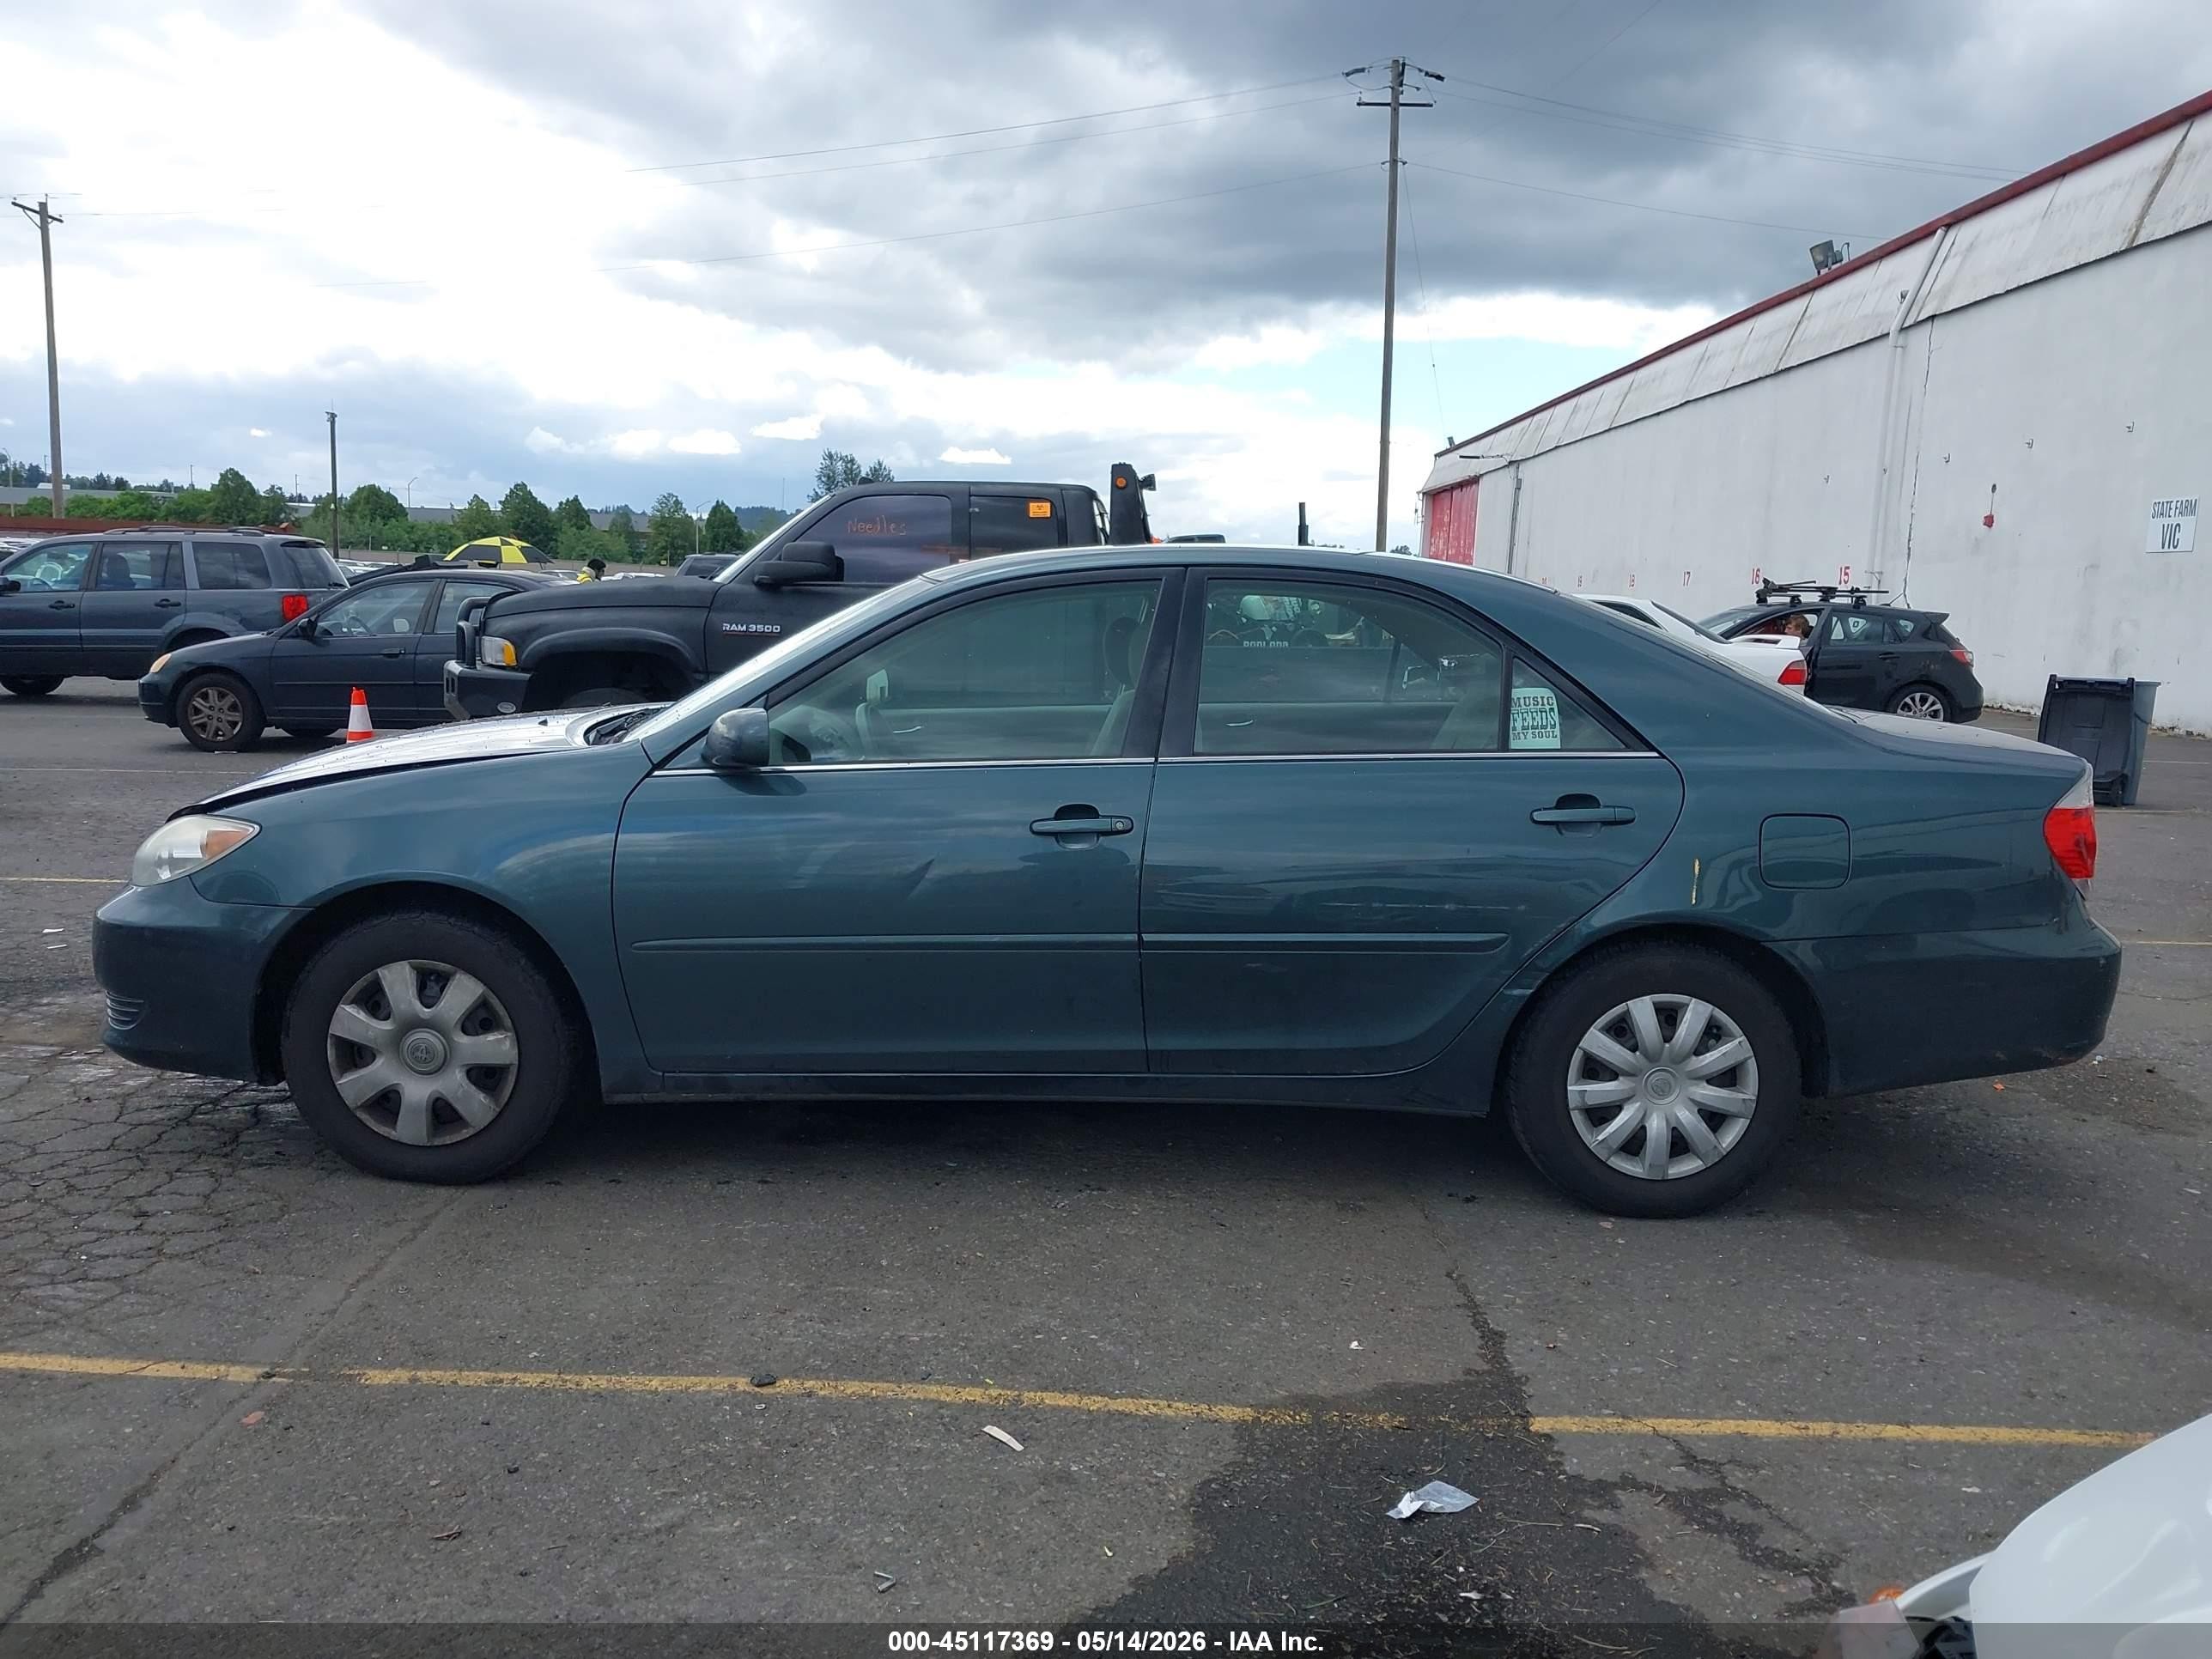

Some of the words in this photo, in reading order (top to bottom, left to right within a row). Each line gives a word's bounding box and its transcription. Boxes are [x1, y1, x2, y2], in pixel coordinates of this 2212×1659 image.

[2151, 501, 2173, 519] STATE
[2173, 499, 2197, 518] FARM
[847, 515, 907, 536] Needles
[2161, 523, 2181, 550] VIC
[1682, 571, 1691, 586] 17
[1752, 568, 1760, 585] 16
[1838, 566, 1850, 586] 15
[722, 623, 747, 632] RAM
[748, 623, 781, 633] 3500
[1511, 696, 1554, 708] MUSIC
[1511, 708, 1557, 731] FEEDS
[1512, 731, 1528, 741] MY
[1531, 730, 1558, 739] SOUL
